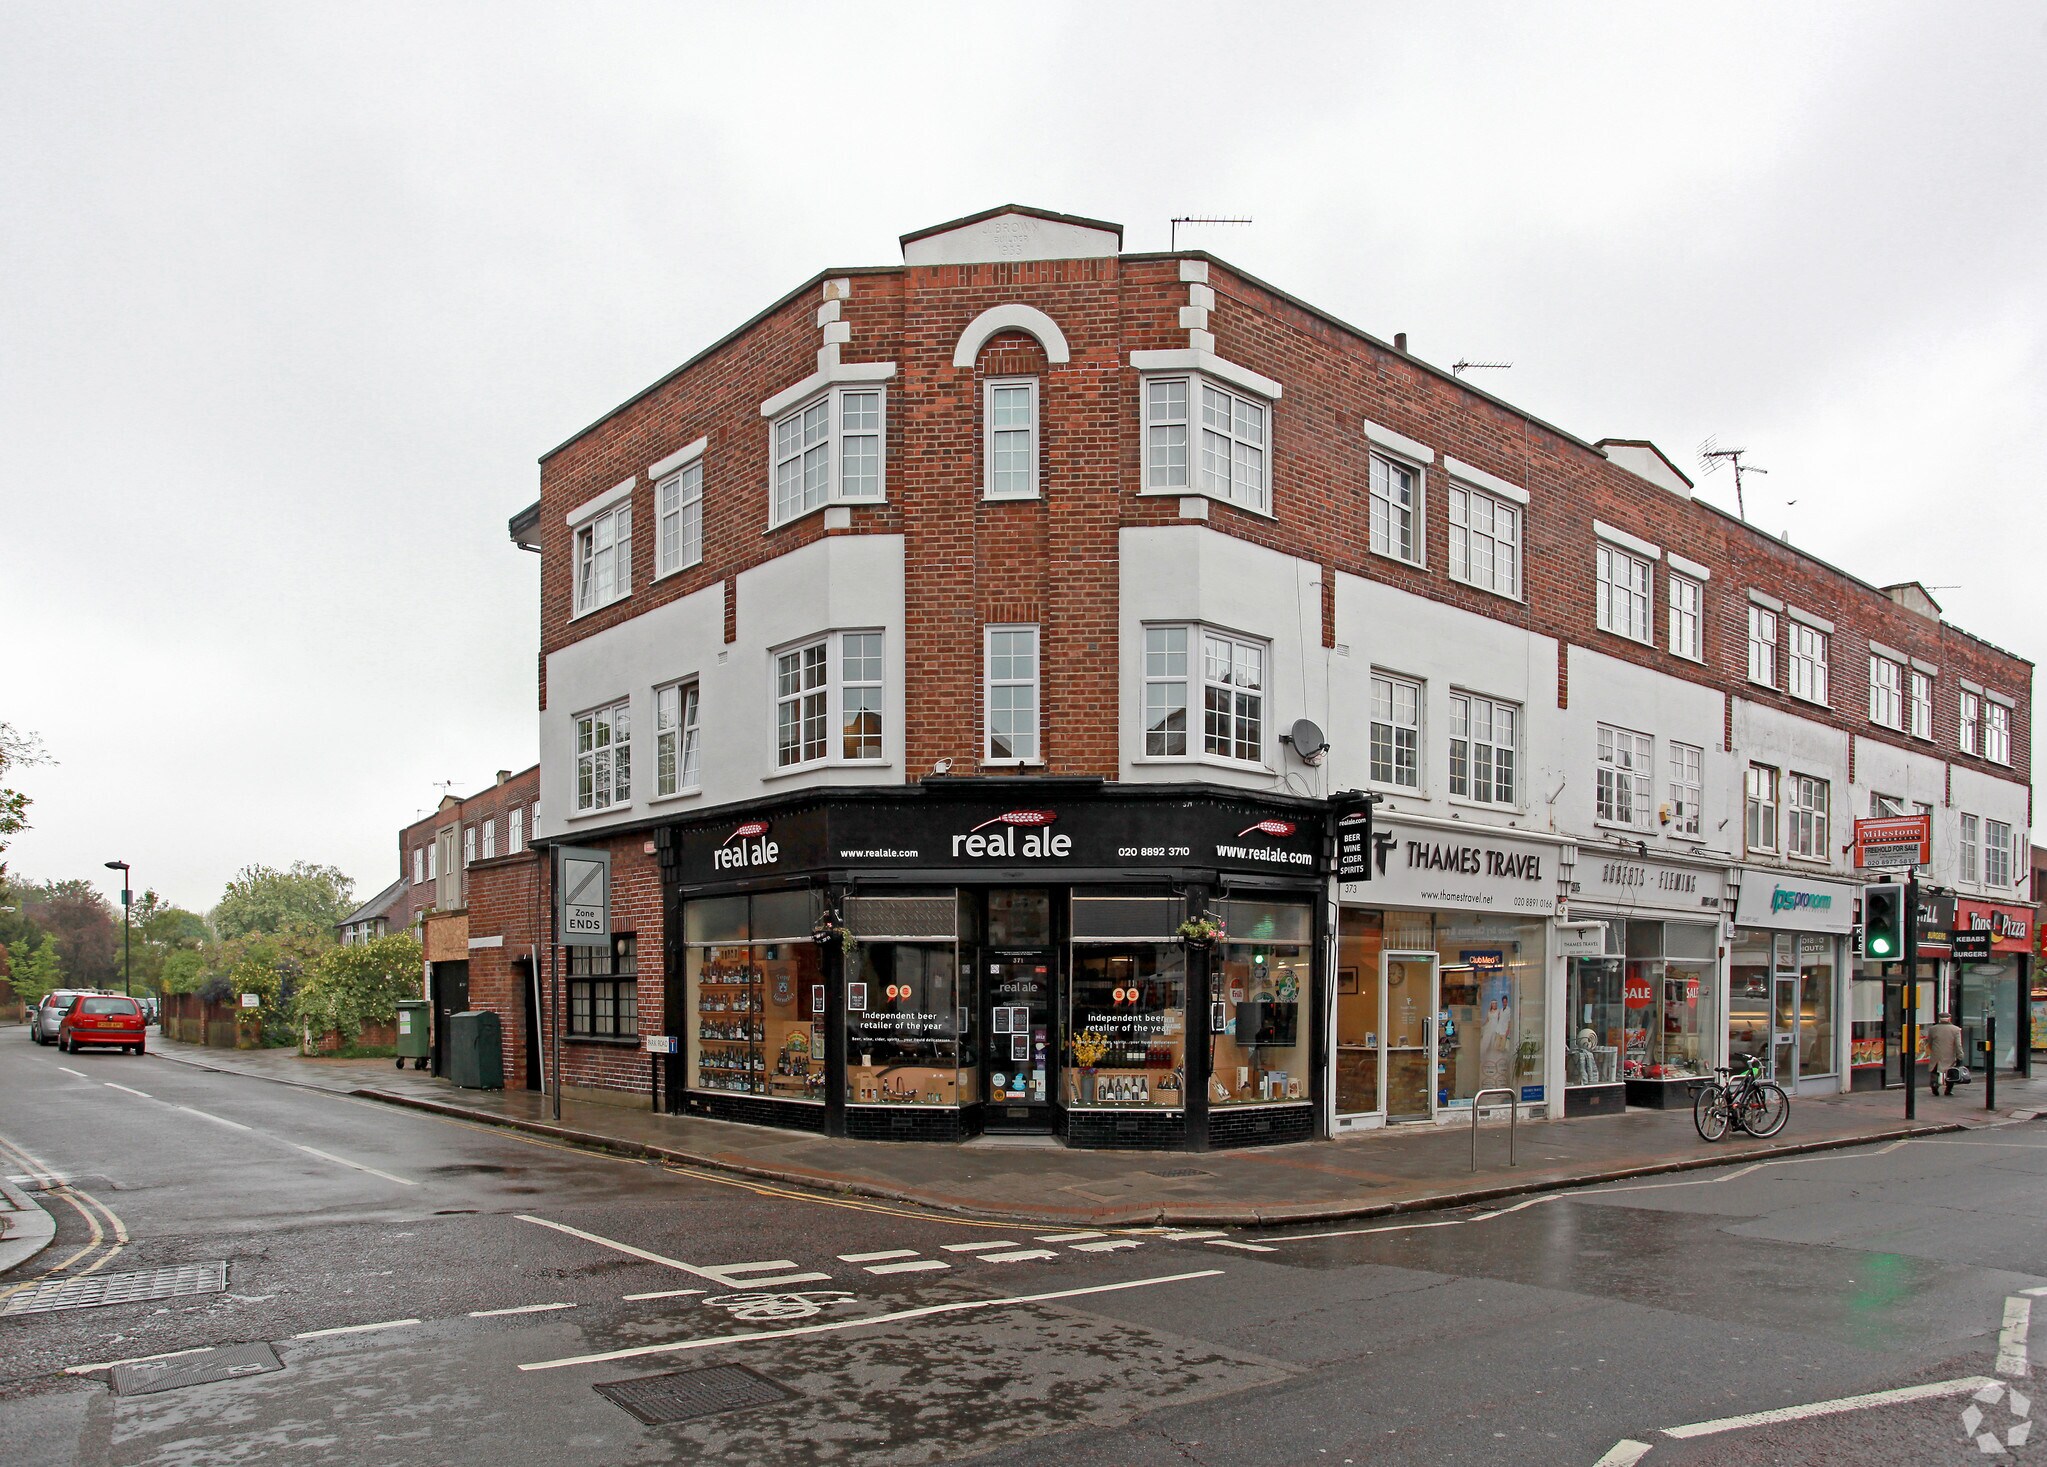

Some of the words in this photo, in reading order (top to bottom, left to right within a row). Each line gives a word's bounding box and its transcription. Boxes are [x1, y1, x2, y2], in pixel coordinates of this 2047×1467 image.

[1339, 817, 1367, 826] realale.com
[1344, 833, 1361, 842] BEER
[1864, 829, 1920, 838] Milestone
[952, 826, 1015, 857] real
[1022, 826, 1072, 857] ale
[714, 838, 748, 870] real
[751, 836, 779, 865] ale
[840, 848, 919, 858] www.realale.com
[1118, 847, 1138, 857] 020
[1141, 847, 1165, 857] 8892
[1168, 846, 1190, 856] 3710
[1344, 844, 1361, 853] WINE
[1215, 843, 1313, 865] www.realale.com
[1342, 854, 1362, 863] CIDER
[1407, 841, 1481, 874] THAMES
[1486, 850, 1542, 881] TRAVEL
[1340, 864, 1364, 875] SPIRITS
[1658, 871, 1697, 893] FLEMING
[1345, 884, 1357, 894] 373
[1420, 889, 1493, 904] www.thamestravel.net
[1513, 896, 1525, 906] 020
[1526, 898, 1538, 908] 8891
[1539, 899, 1553, 909] 0166
[575, 909, 595, 918] Zone
[569, 919, 600, 930] ENDS
[2002, 914, 2026, 937] Pizza
[999, 982, 1020, 992] real
[1022, 982, 1038, 992] ale
[1623, 987, 1651, 999] SALE
[862, 1011, 915, 1021] Independent
[917, 1012, 937, 1020] beer
[1088, 1014, 1142, 1023] Independent
[1145, 1014, 1165, 1022] beer
[907, 1022, 921, 1030] the
[923, 1023, 942, 1031] year
[1085, 1024, 1119, 1032] retailer
[1122, 1024, 1131, 1032] of
[1136, 1024, 1148, 1032] the
[1151, 1025, 1170, 1033] year
[657, 1039, 668, 1047] ROAD
